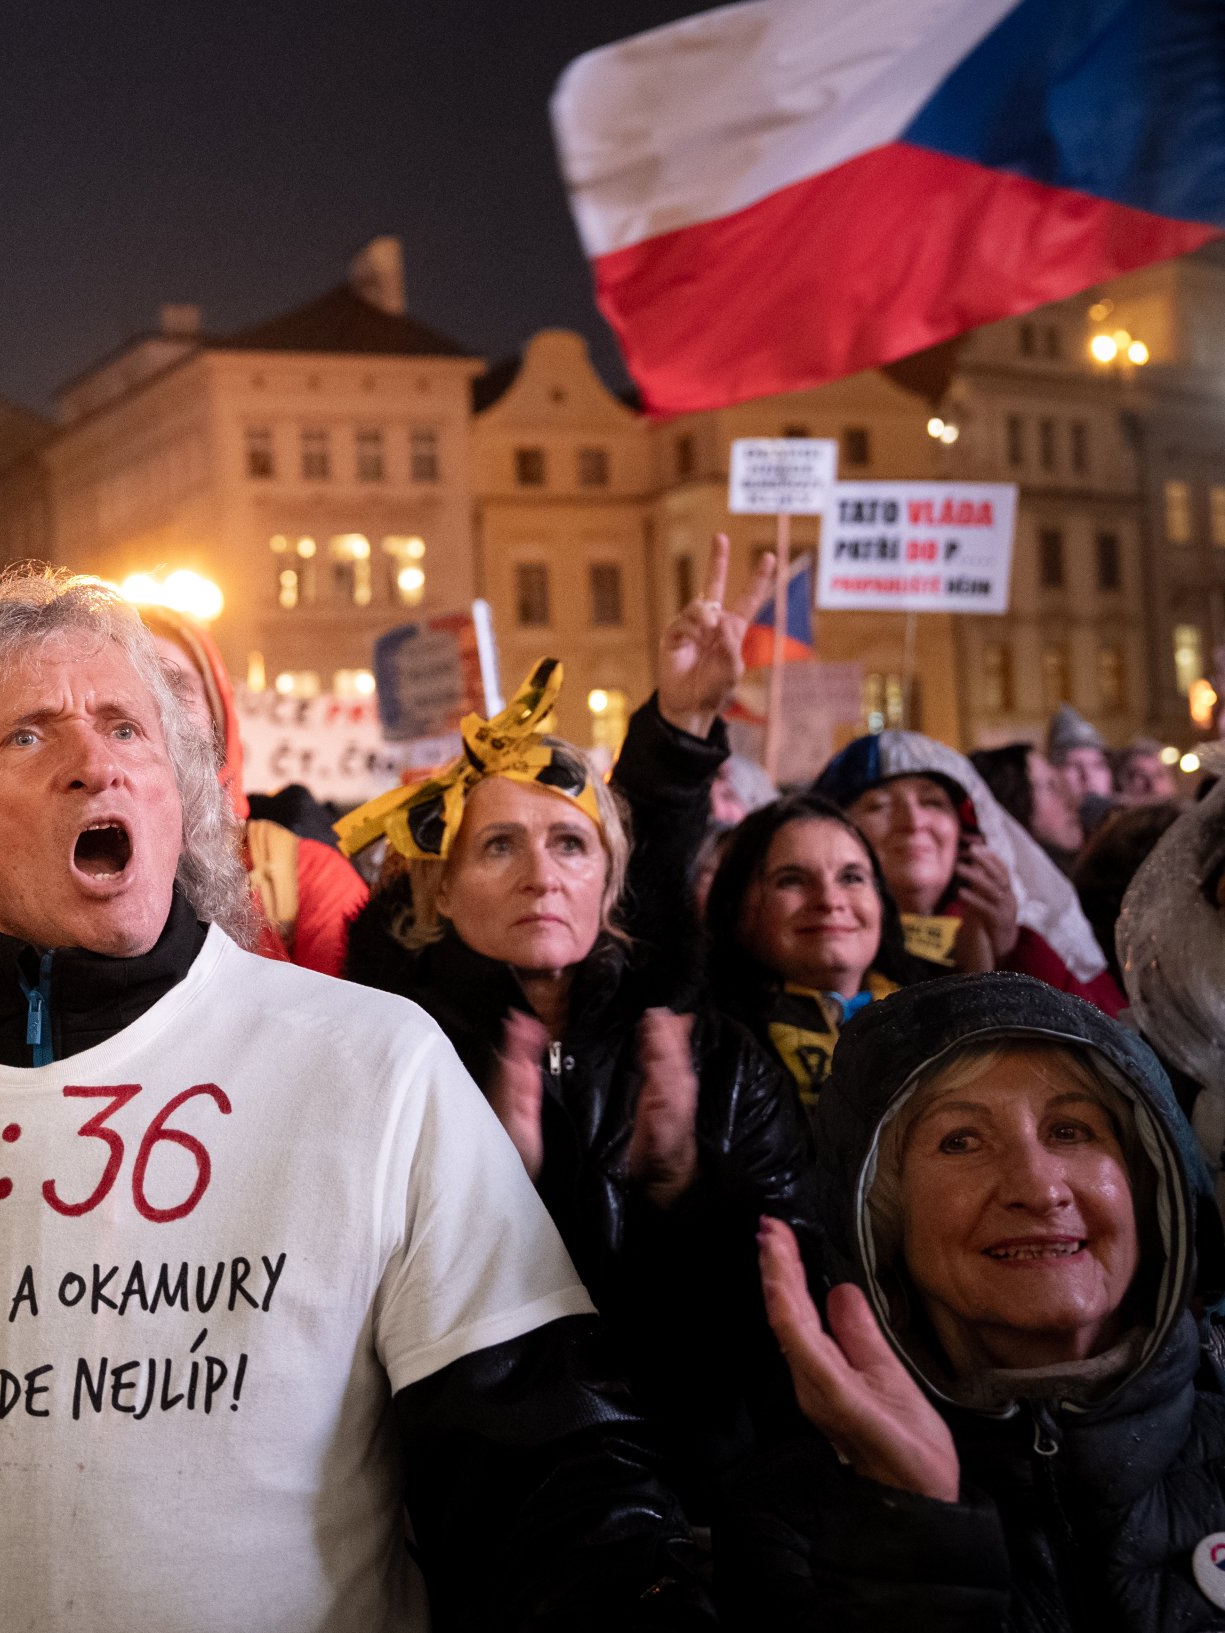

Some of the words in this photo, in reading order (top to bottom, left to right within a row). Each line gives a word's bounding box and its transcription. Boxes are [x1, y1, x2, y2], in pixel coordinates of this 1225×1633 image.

[838, 499, 899, 524] TATO
[907, 496, 994, 527] VLÁDA
[906, 540, 939, 562] DO
[8, 1264, 39, 1323] A
[57, 1252, 287, 1316] OKAMURY
[72, 1328, 249, 1420] NEJLÍP!
